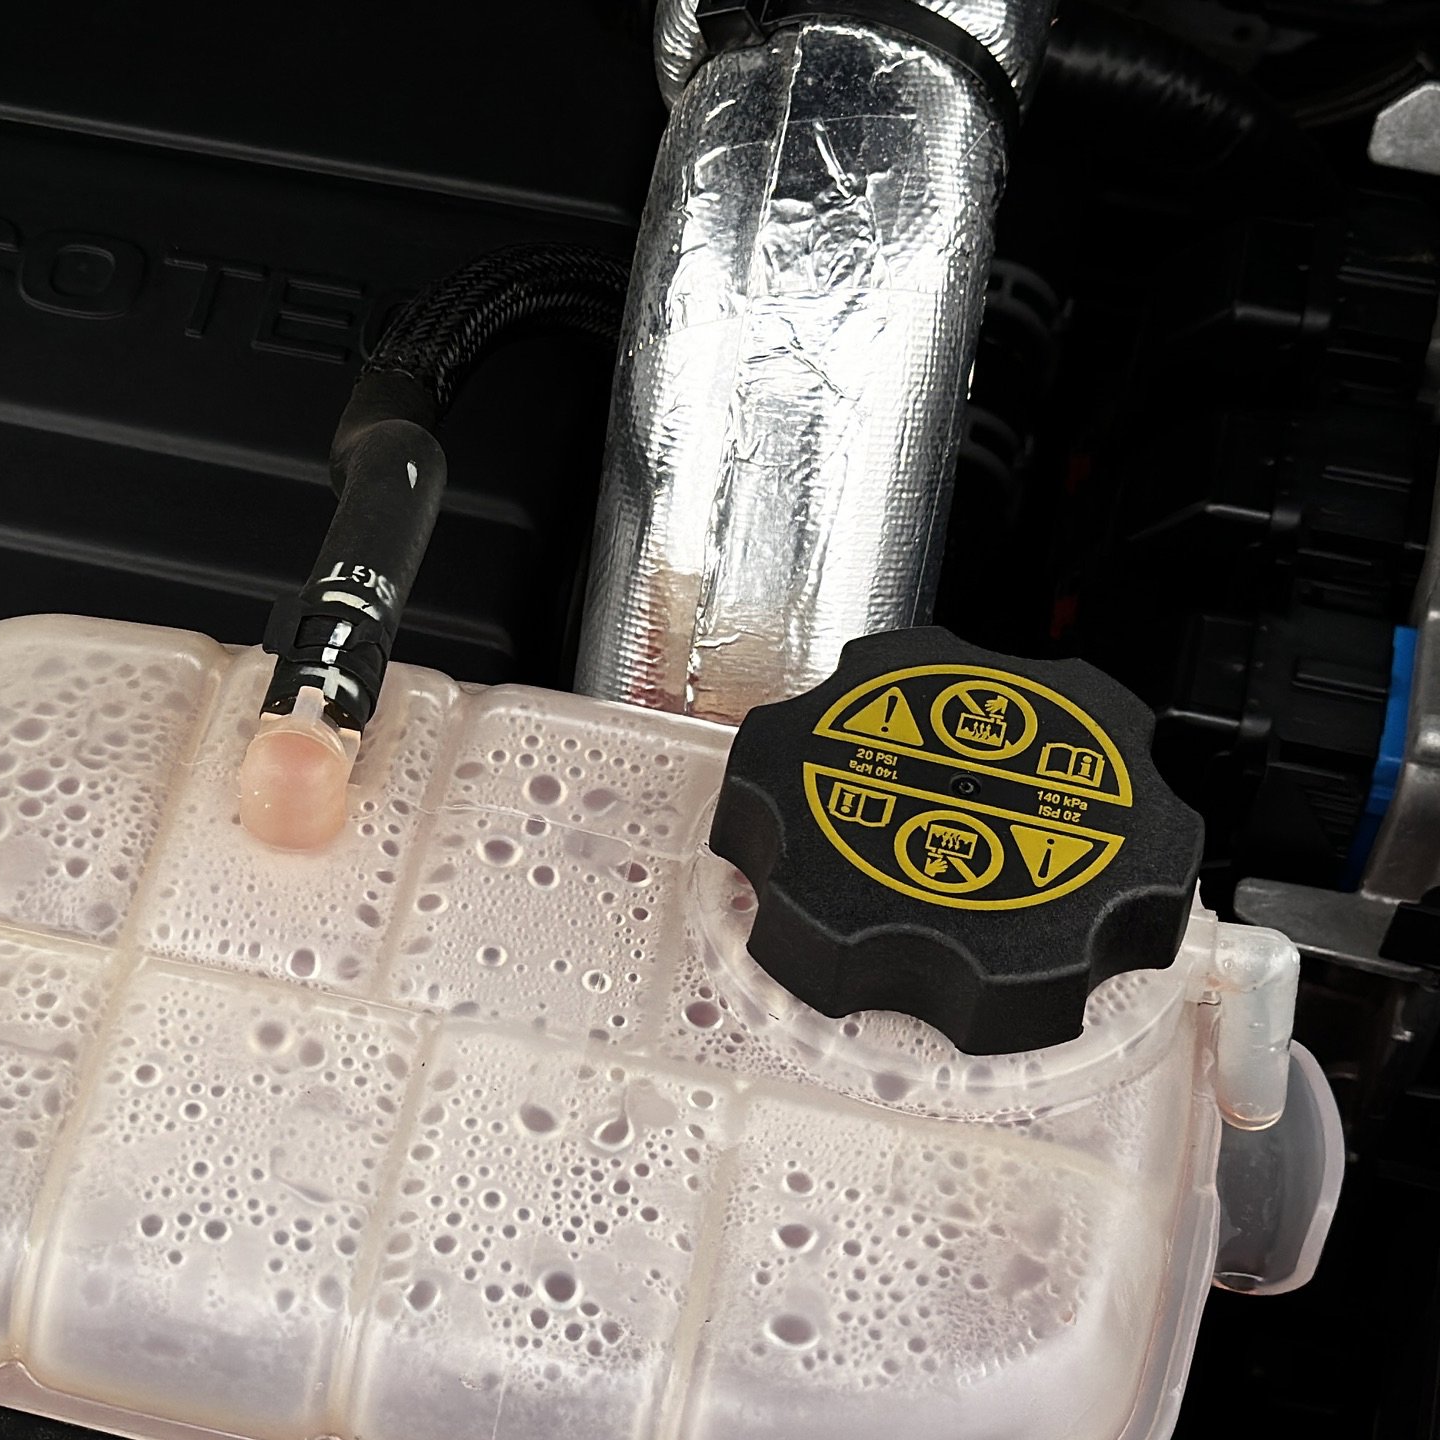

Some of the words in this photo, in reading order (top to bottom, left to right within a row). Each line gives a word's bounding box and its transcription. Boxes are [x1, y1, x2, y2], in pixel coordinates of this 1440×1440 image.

[855, 747, 874, 761] 20
[875, 752, 898, 766] PSI
[849, 759, 872, 775] kPa
[875, 767, 899, 780] 140
[1037, 790, 1061, 805] 140
[1063, 795, 1088, 811] kPa
[1038, 804, 1060, 820] PSI
[1063, 811, 1081, 823] 20
